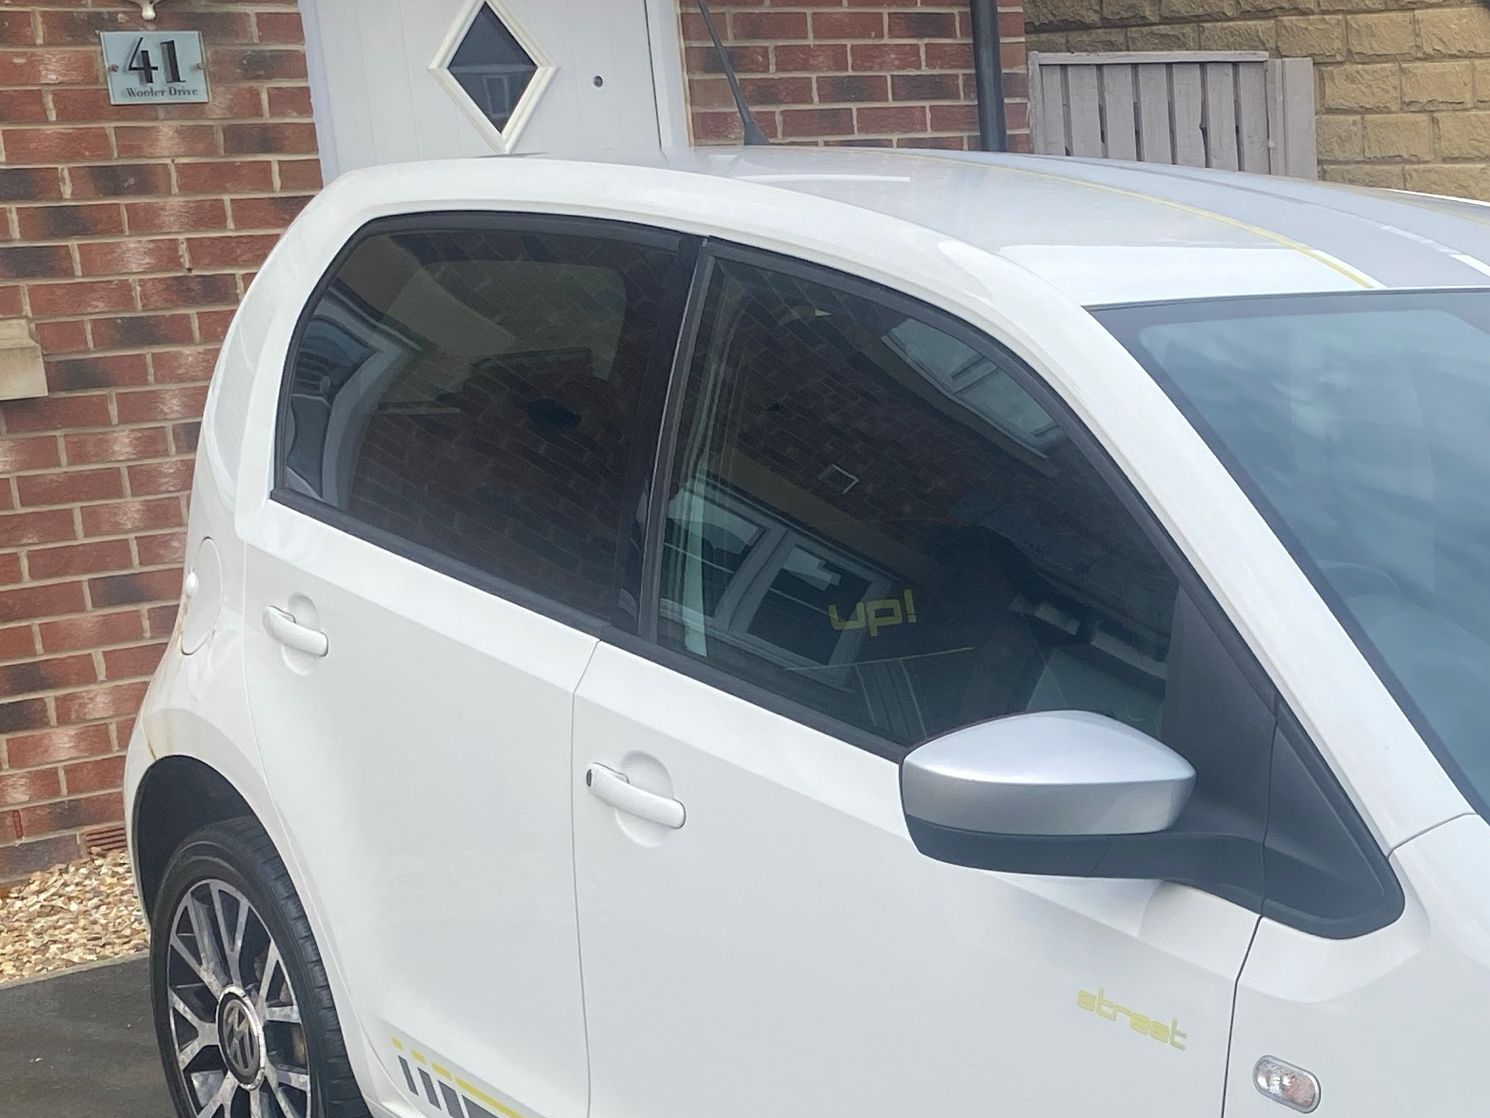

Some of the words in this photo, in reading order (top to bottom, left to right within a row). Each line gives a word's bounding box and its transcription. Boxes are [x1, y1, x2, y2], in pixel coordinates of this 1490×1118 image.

[127, 36, 187, 84] 41
[126, 86, 165, 98] Wooler
[168, 85, 198, 97] Drive
[827, 588, 917, 637] up!
[1077, 987, 1188, 1051] street
